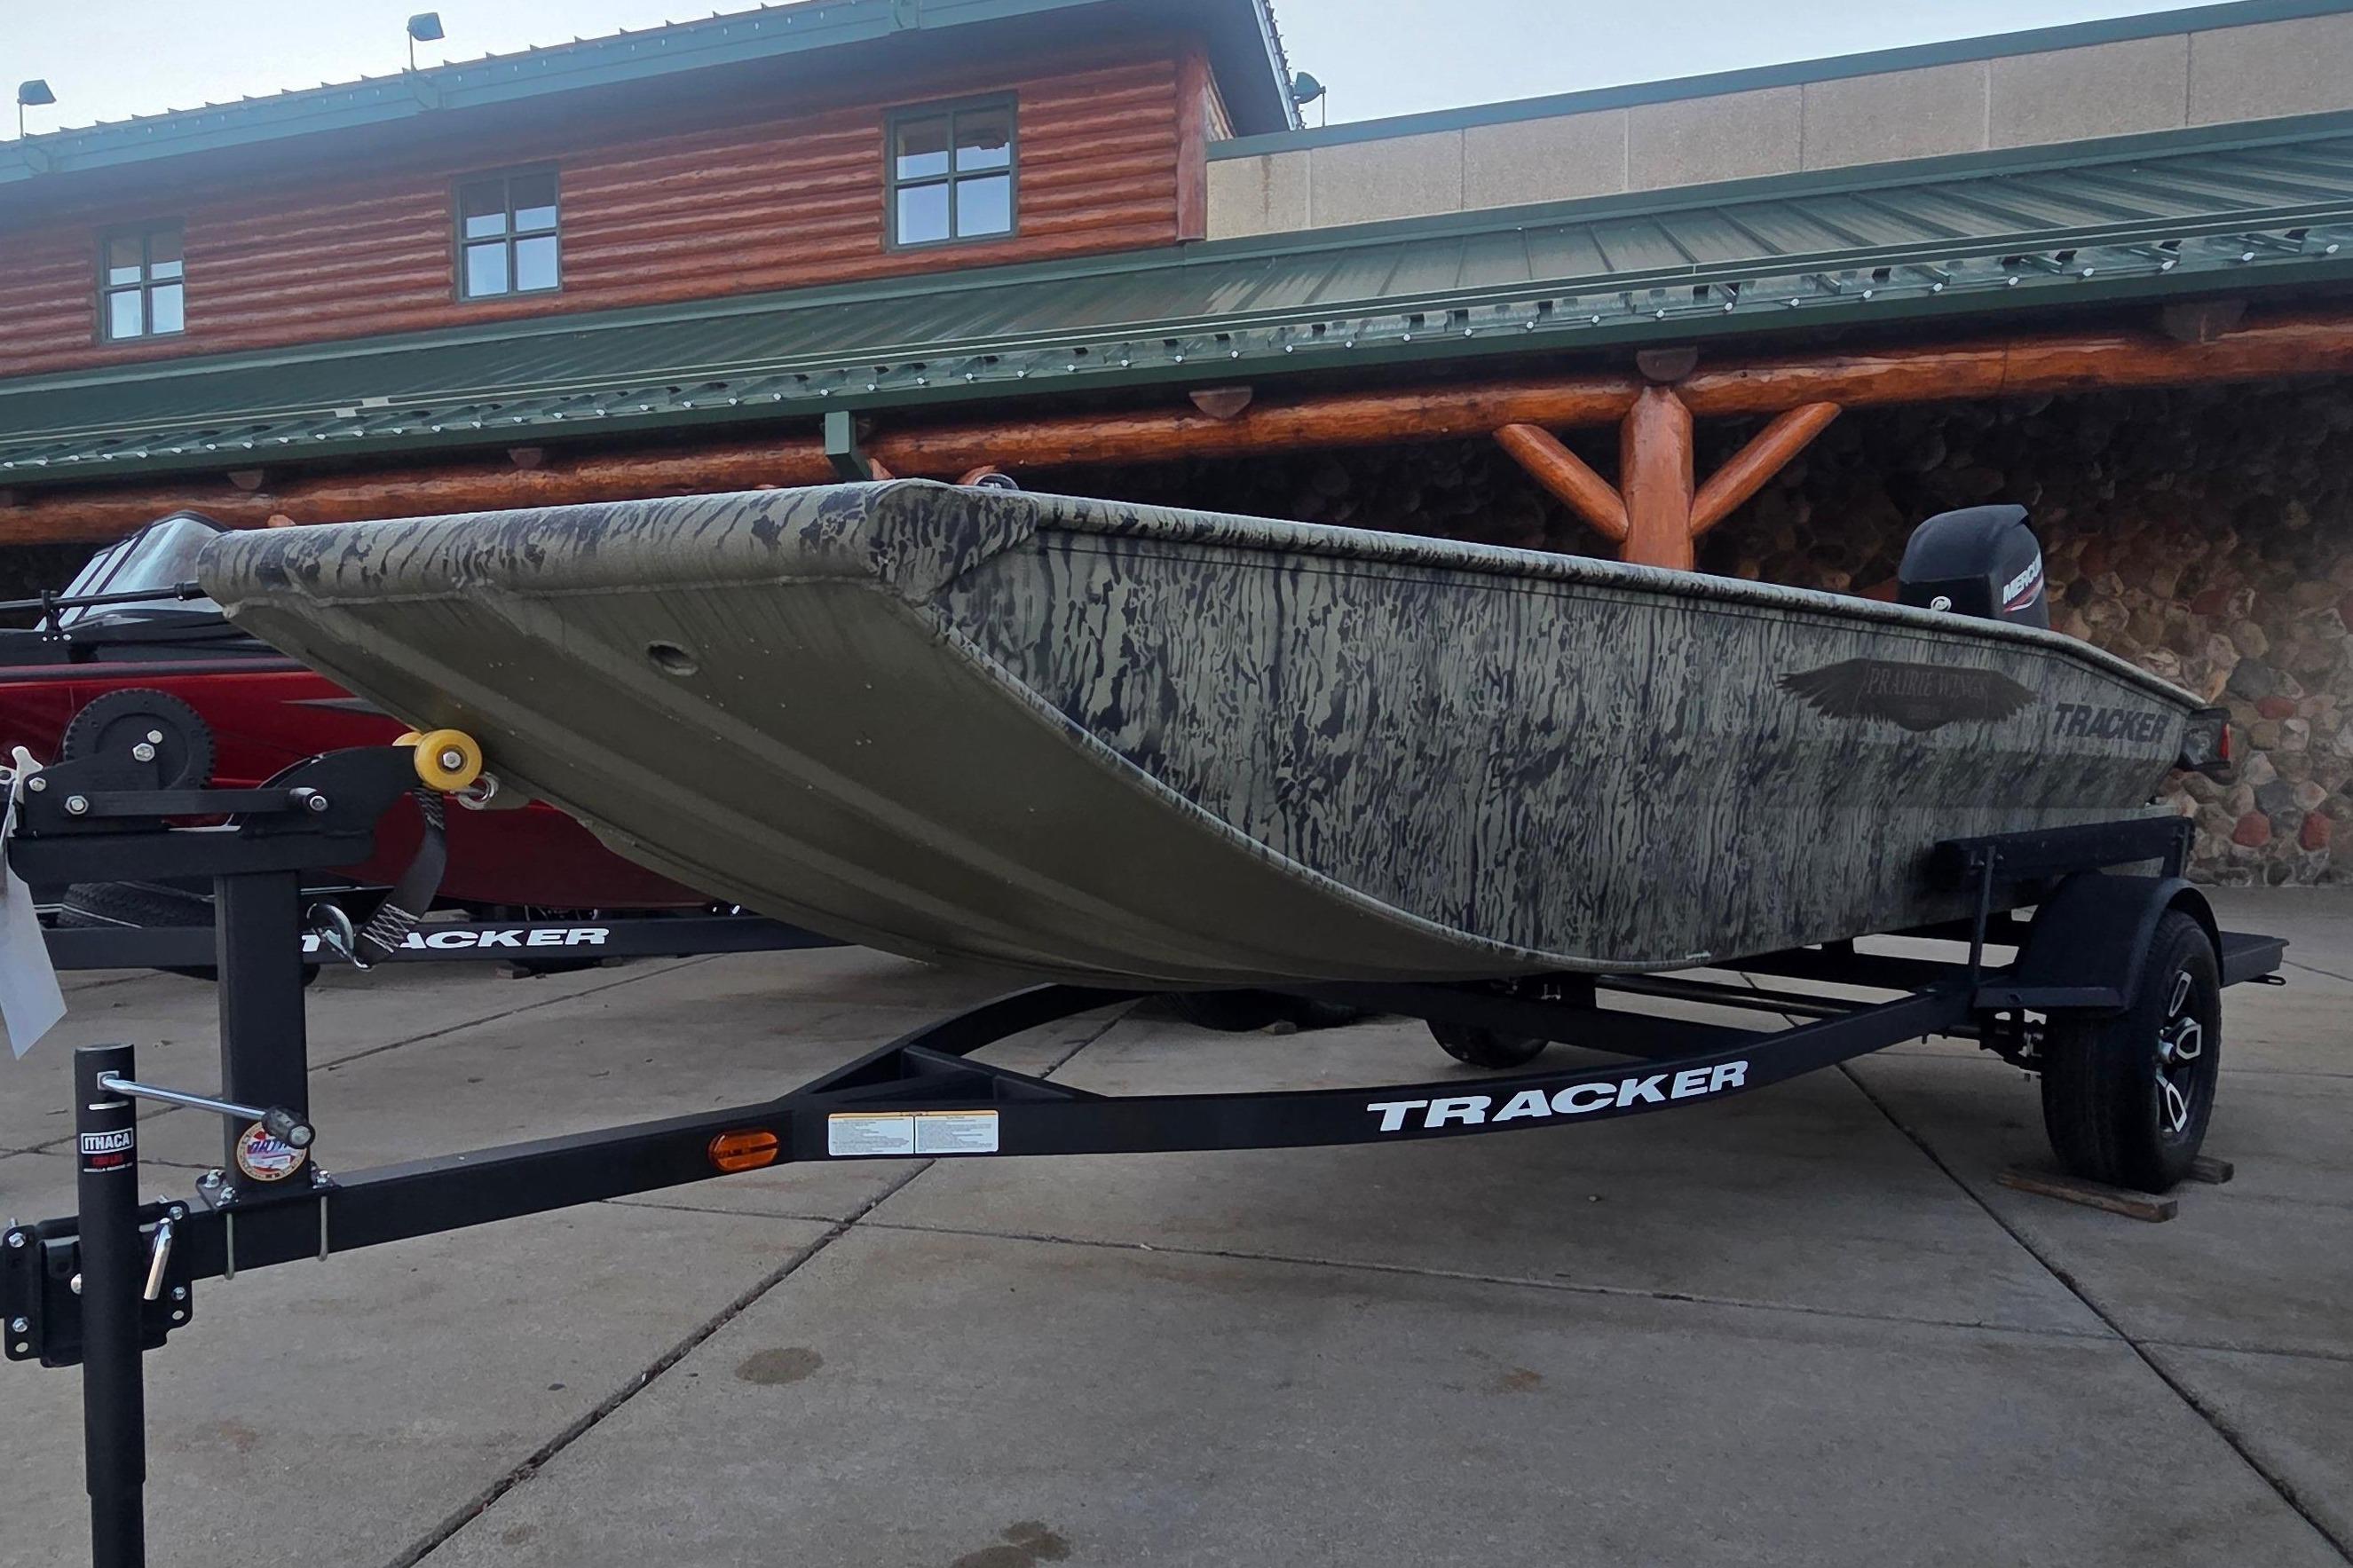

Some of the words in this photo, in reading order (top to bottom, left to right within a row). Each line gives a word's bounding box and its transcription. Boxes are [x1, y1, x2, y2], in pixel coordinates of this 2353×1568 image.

[2002, 551, 2041, 604] MERCU
[1867, 667, 1933, 697] PRAIRIE
[2052, 701, 2170, 744] TRACKER
[301, 928, 610, 952] TACKER
[1367, 1060, 1749, 1132] TRACKER
[84, 1132, 130, 1150] ITHACA
